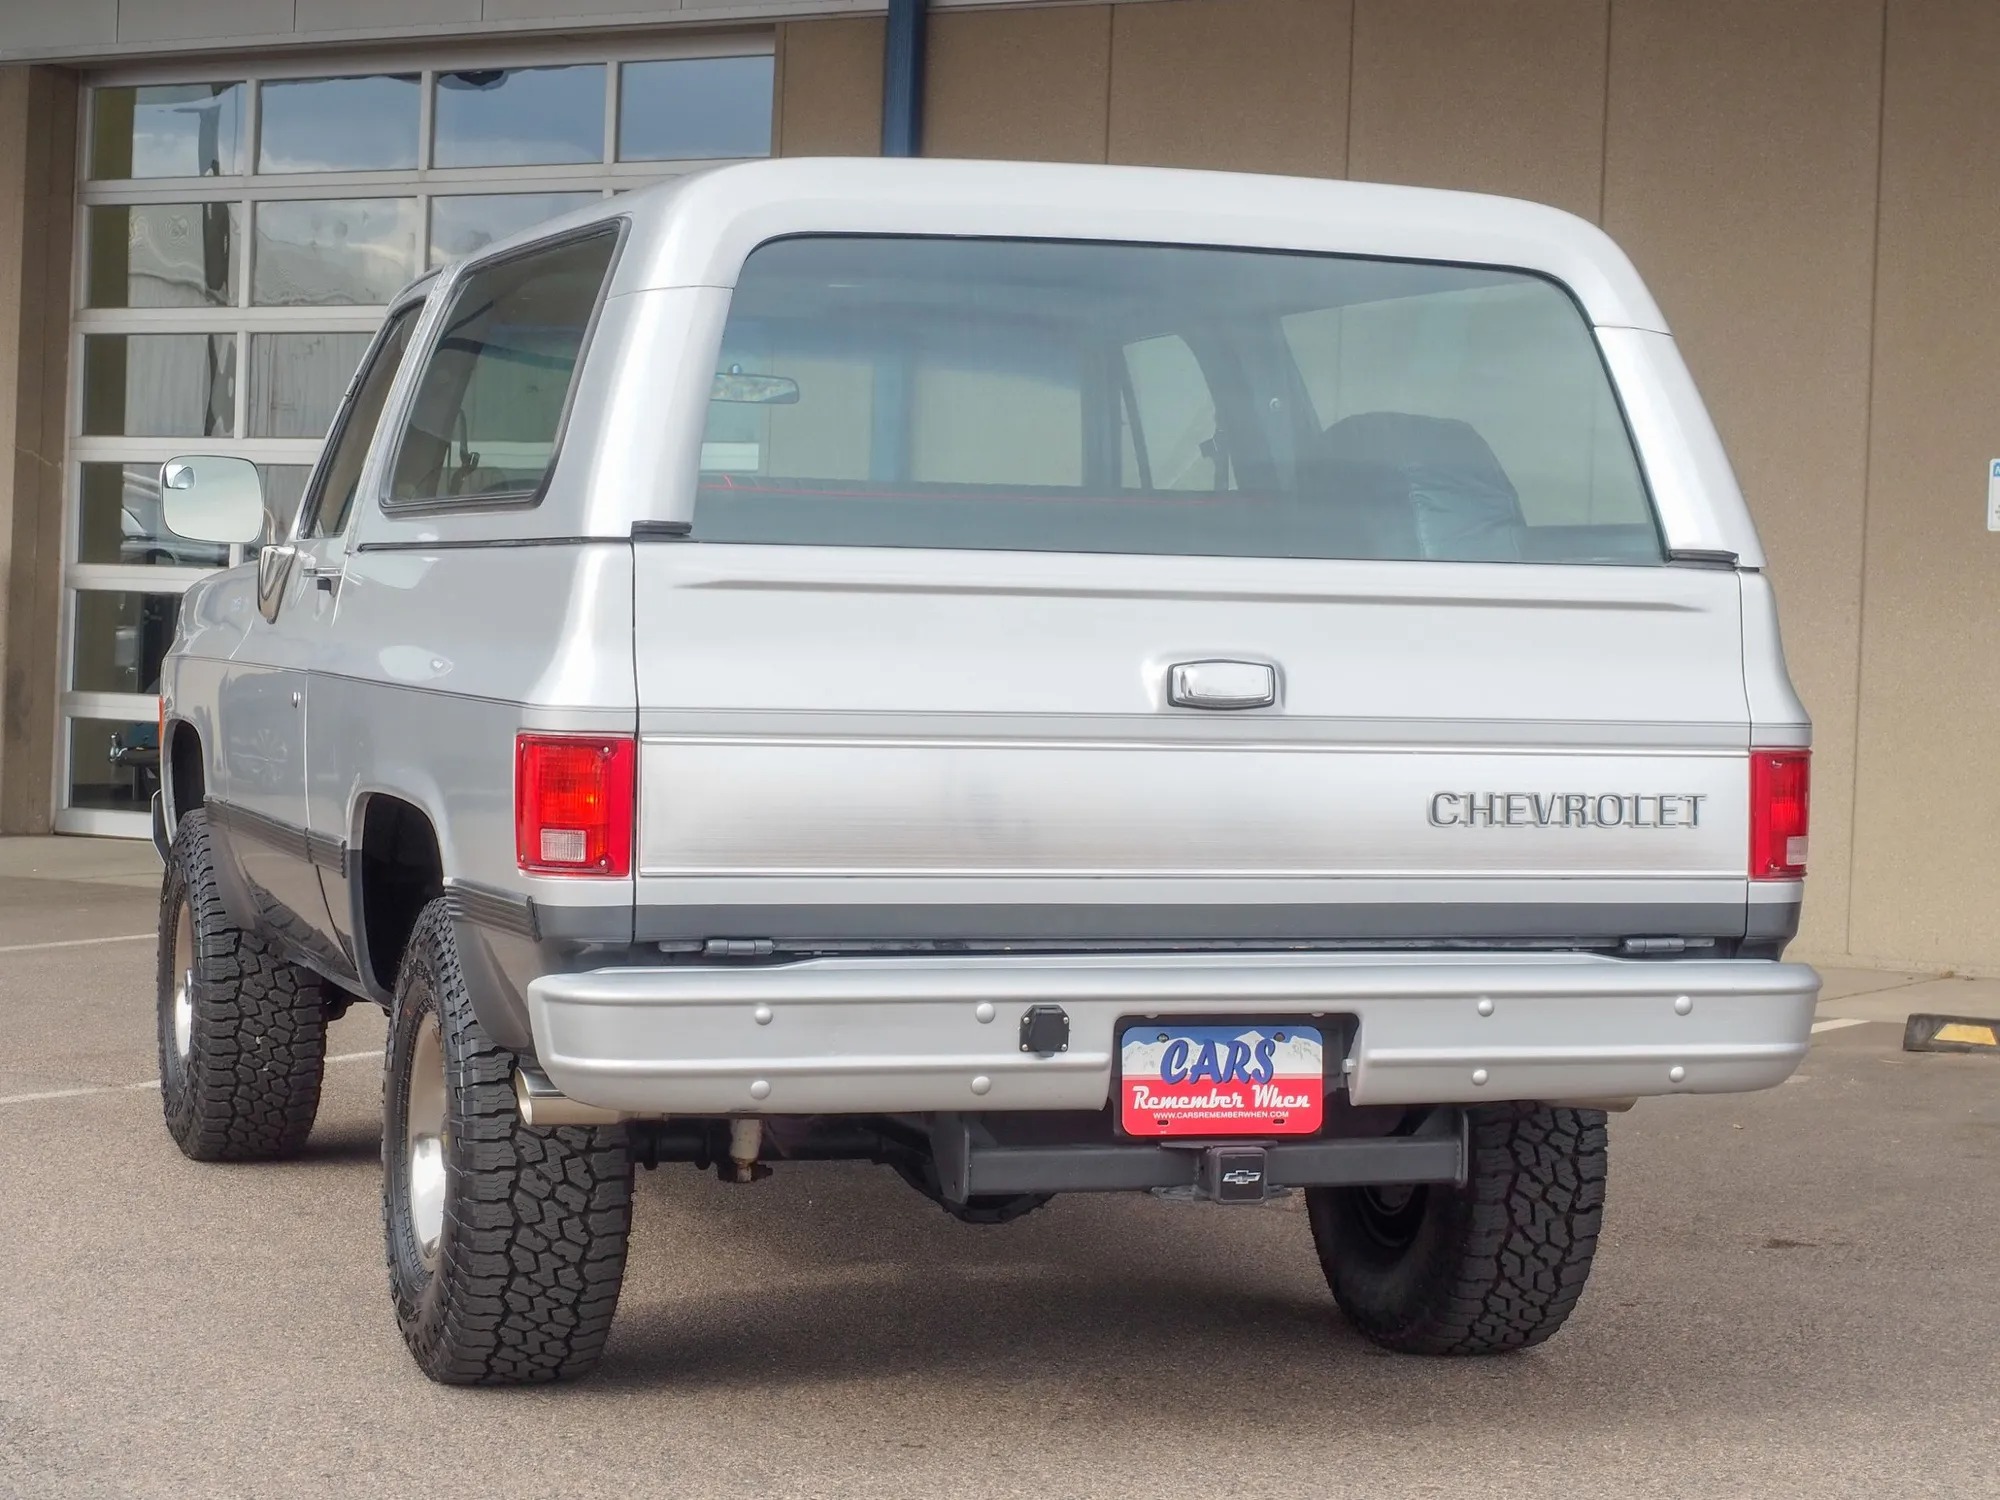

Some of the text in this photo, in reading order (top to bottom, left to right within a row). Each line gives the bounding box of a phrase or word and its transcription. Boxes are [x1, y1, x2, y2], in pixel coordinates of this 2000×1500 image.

[1428, 791, 1707, 829] CHEVROLET
[1160, 1038, 1276, 1085] CARS
[1132, 1084, 1311, 1110] Remember When
[1153, 1111, 1289, 1119] WWW.CARSREMEMBERWHEN.COM
